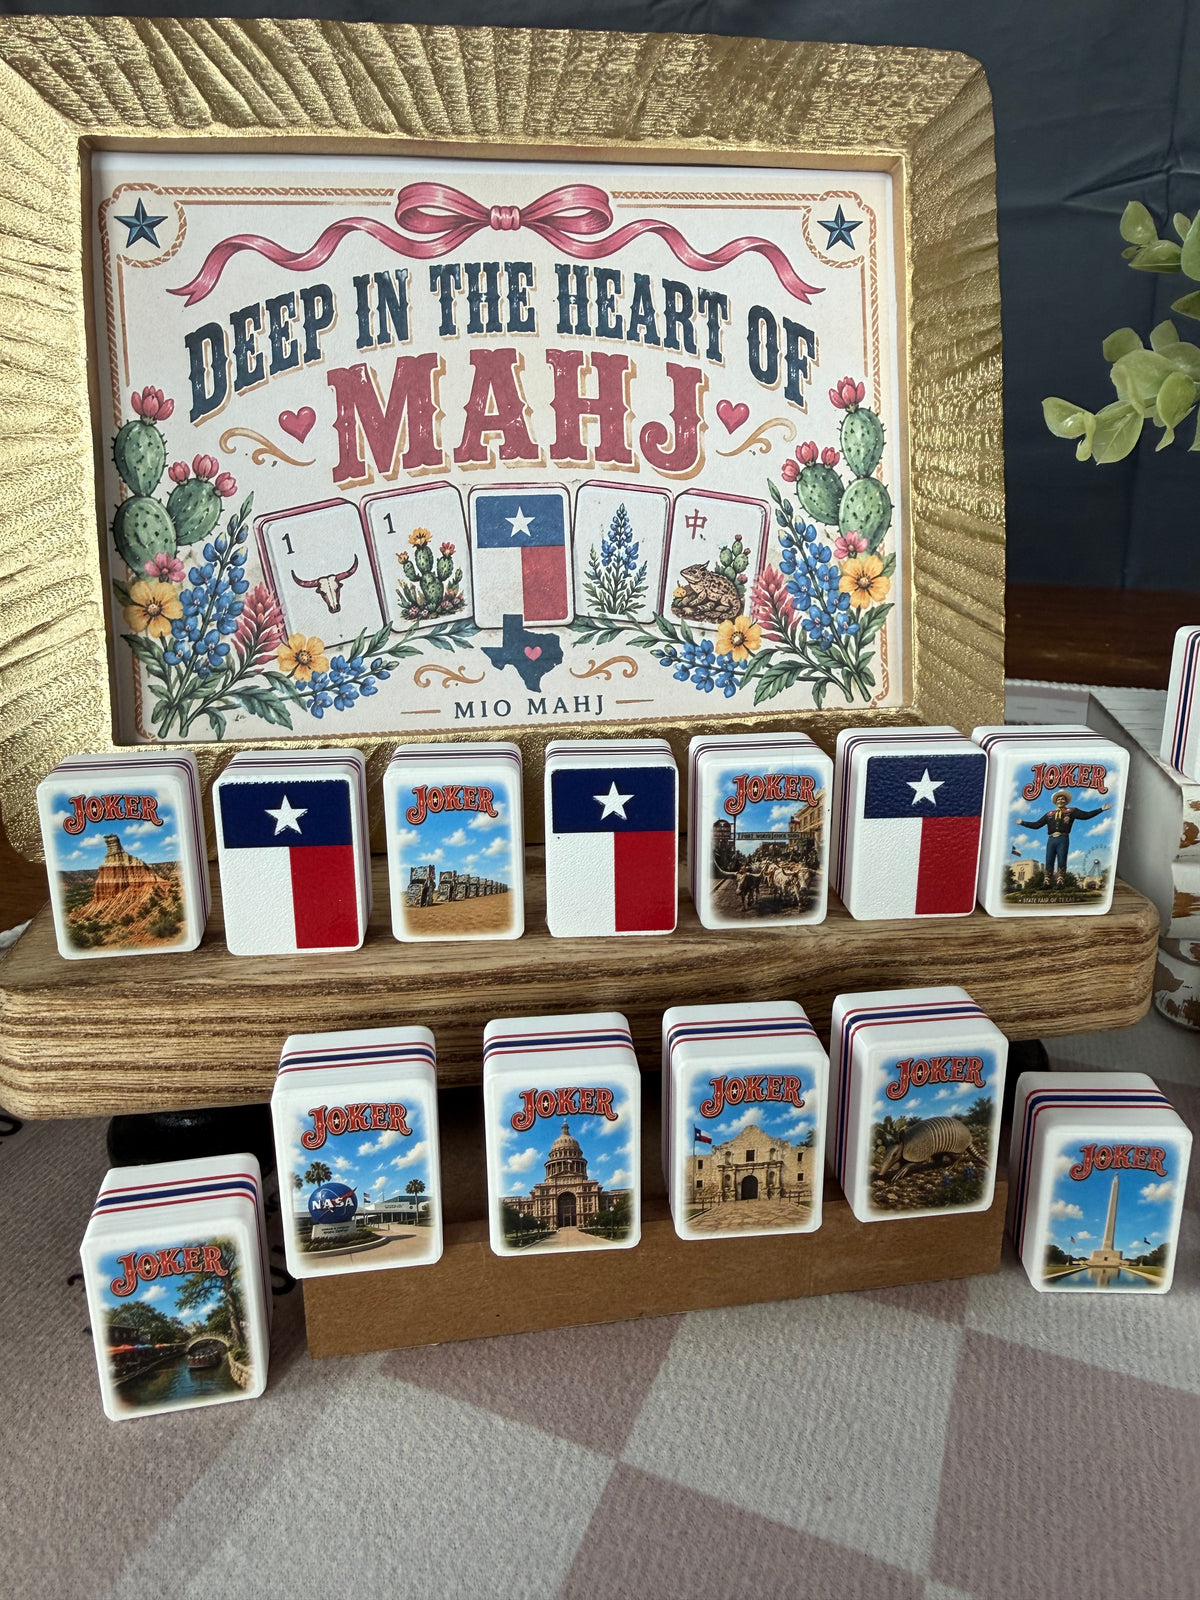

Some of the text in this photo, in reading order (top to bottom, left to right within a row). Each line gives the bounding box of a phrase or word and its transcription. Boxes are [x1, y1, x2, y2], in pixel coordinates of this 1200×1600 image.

[184, 262, 819, 427] DEEP IN THE HEART OF
[327, 348, 709, 490] MAHJ
[281, 533, 295, 555] 1
[383, 512, 396, 534] 1
[685, 508, 708, 540] 中
[454, 694, 604, 719] MIO MAHJ
[723, 774, 819, 816] JOKER
[1022, 762, 1109, 801] JOKER
[62, 793, 164, 835] JOKER
[405, 784, 498, 825] JOKER
[700, 1074, 805, 1119] JOKER
[885, 1056, 986, 1100] JOKER
[301, 1103, 412, 1150] JOKER
[511, 1086, 619, 1132] JOKER
[1069, 1143, 1168, 1181] JOKER
[311, 1197, 354, 1211] NASA
[110, 1246, 229, 1298] JOKER
